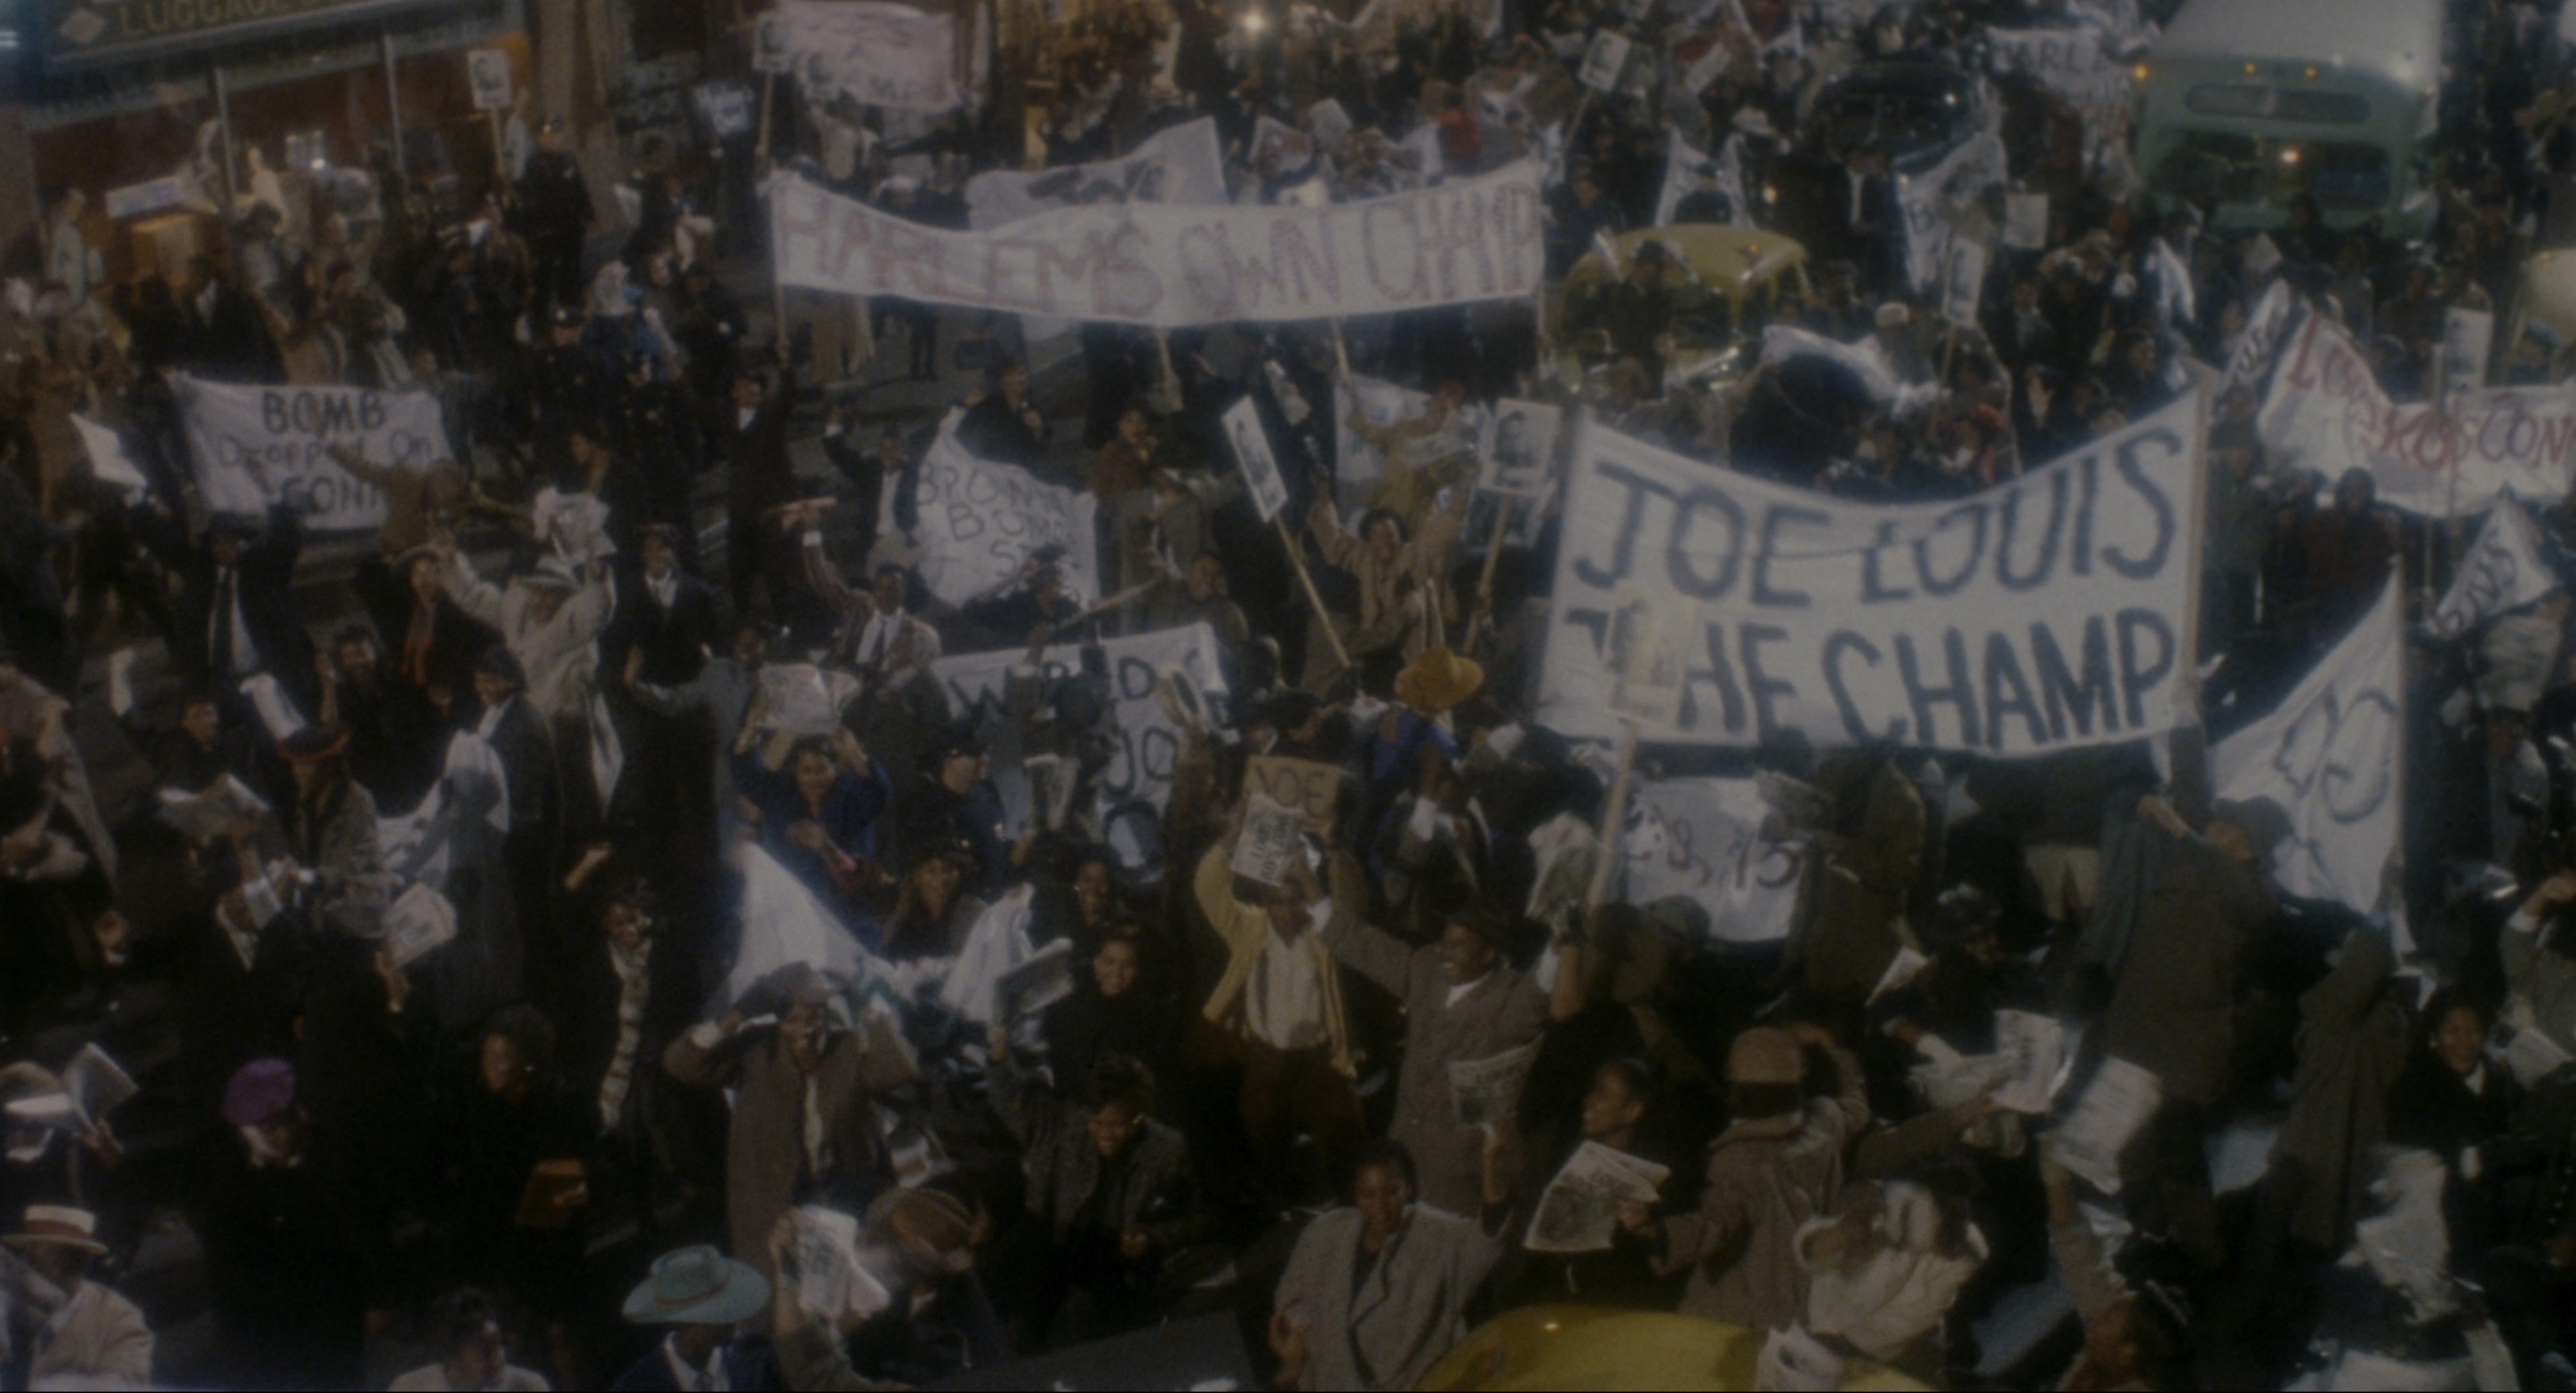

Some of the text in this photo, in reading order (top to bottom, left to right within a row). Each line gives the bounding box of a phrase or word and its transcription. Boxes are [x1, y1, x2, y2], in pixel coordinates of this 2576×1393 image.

[1177, 219, 1342, 319] OWN
[1361, 182, 1542, 302] CHAMP
[262, 390, 386, 433] BOMB
[389, 429, 431, 464] On
[2479, 392, 2575, 468] CON
[1573, 426, 2183, 607] JOE LOUIS
[946, 656, 1157, 718] WRD
[1821, 607, 2176, 750] CHAMP
[1102, 725, 1180, 802] JO
